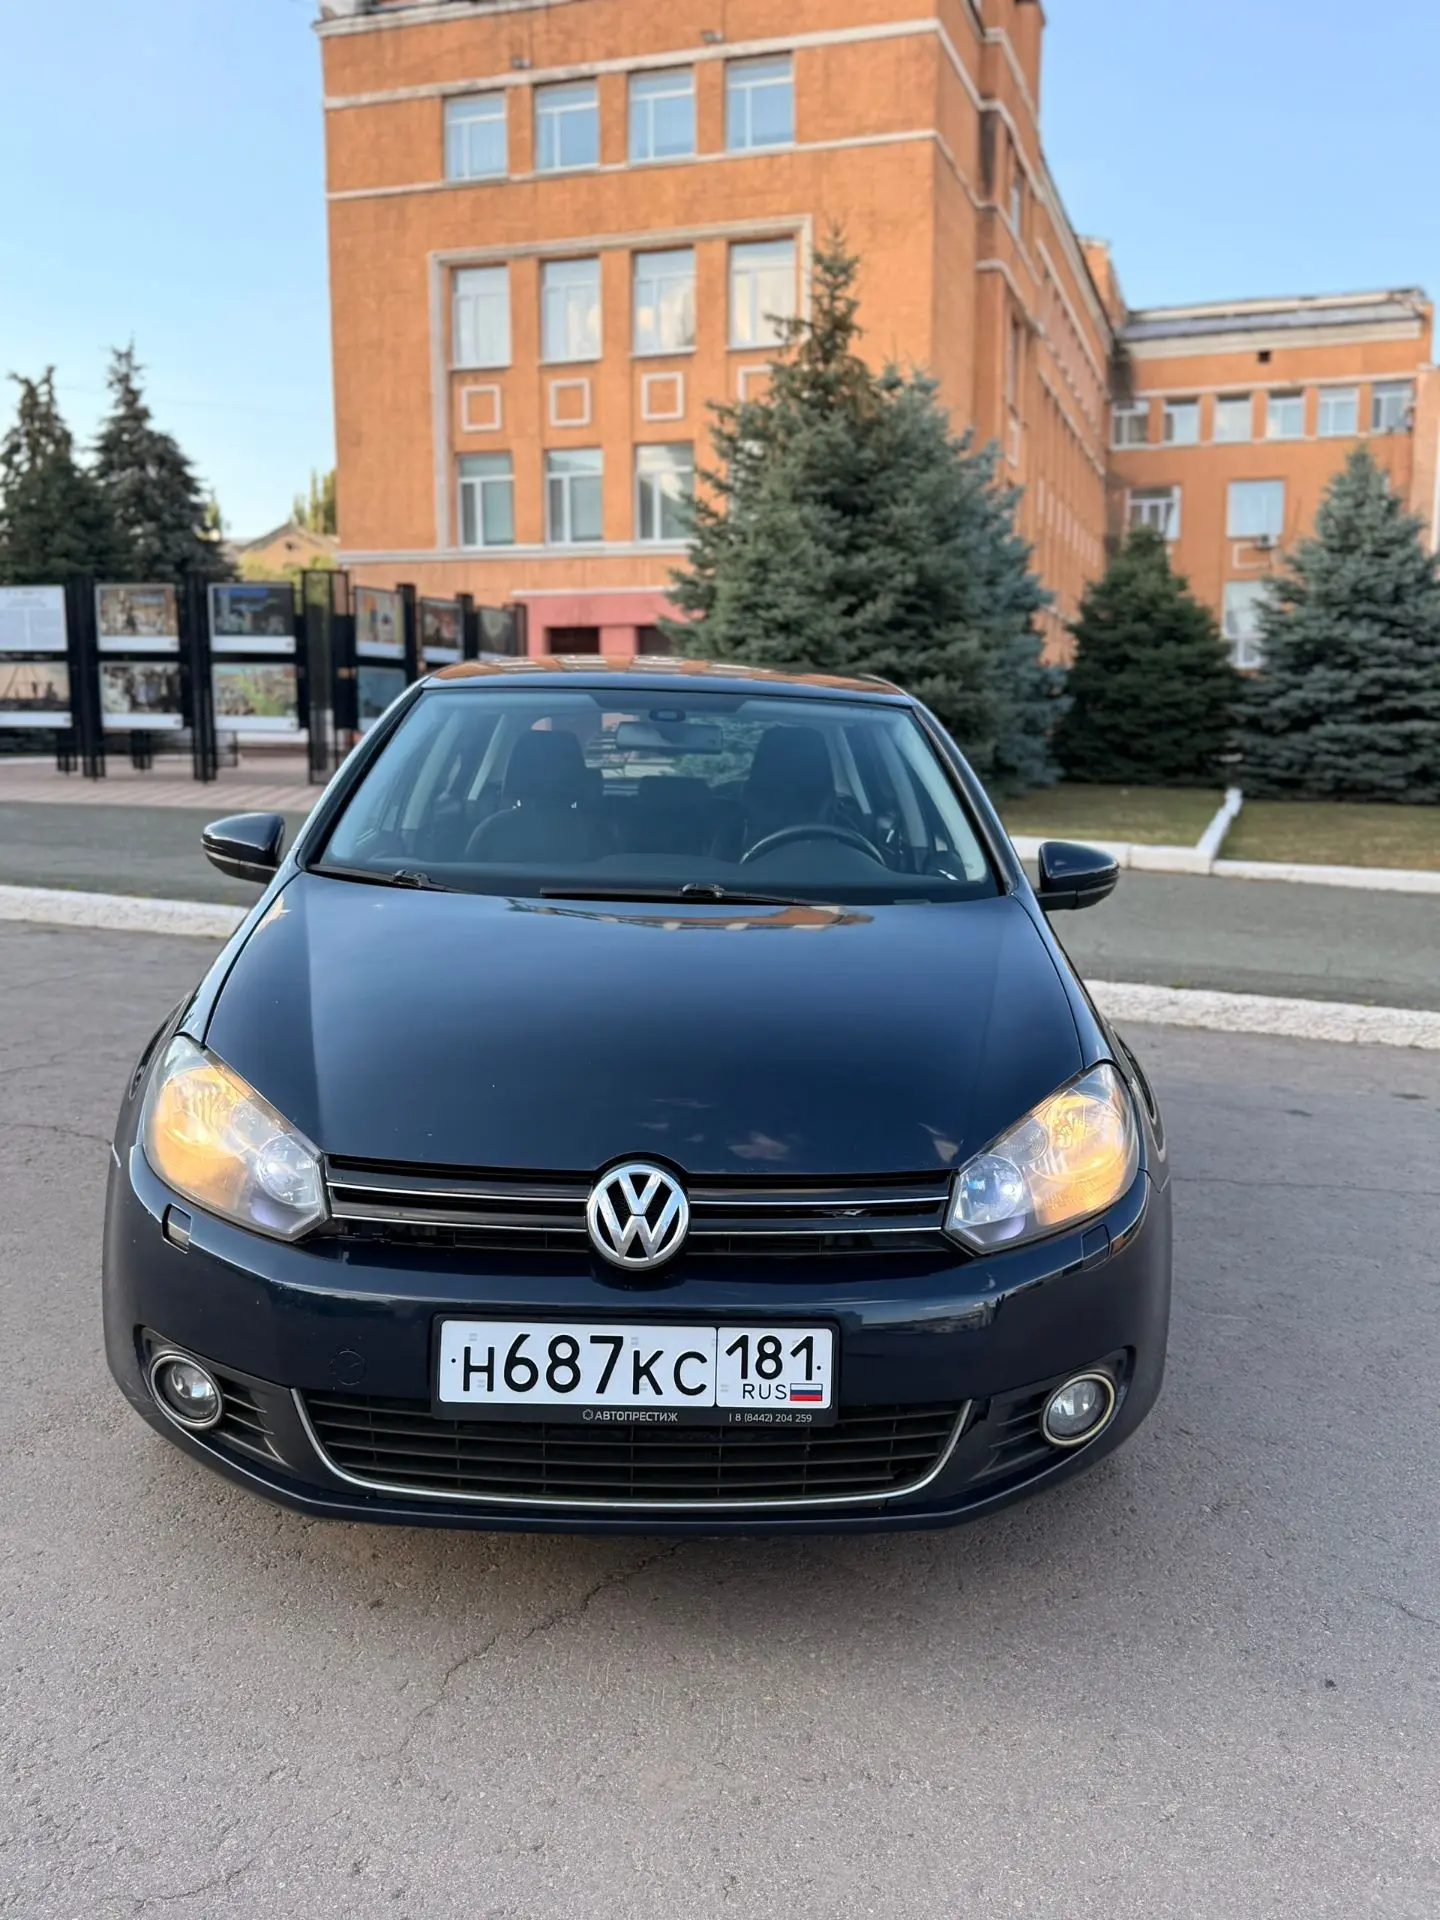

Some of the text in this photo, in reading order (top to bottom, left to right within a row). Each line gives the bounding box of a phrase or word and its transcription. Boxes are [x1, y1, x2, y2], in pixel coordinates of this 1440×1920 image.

[725, 1334, 814, 1381] 181
[742, 1384, 787, 1400] RUS
[595, 1411, 678, 1422] АВТОПРЕСТИЖ
[735, 1413, 812, 1423] 8 (8442) 204 259
